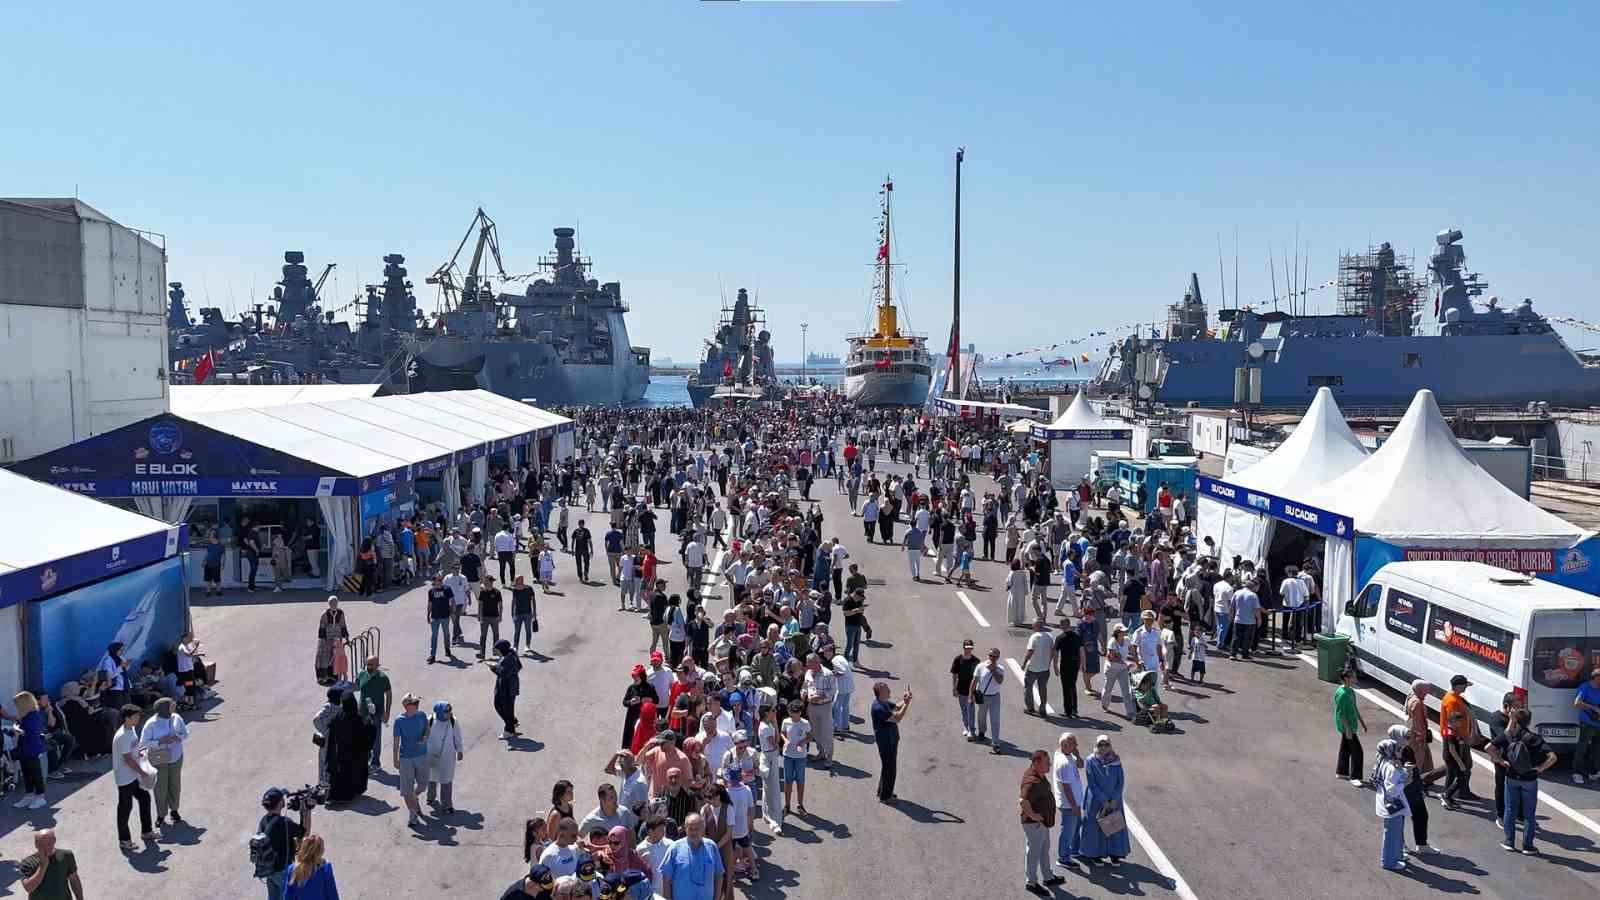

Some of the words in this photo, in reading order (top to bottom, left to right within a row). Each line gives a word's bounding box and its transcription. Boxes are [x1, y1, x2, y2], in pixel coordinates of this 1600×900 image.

[136, 464, 146, 474] E
[149, 464, 198, 475] BLOK
[1285, 504, 1294, 516] SU
[1520, 551, 1552, 571] KURTAR
[1479, 646, 1506, 665] ARACI
